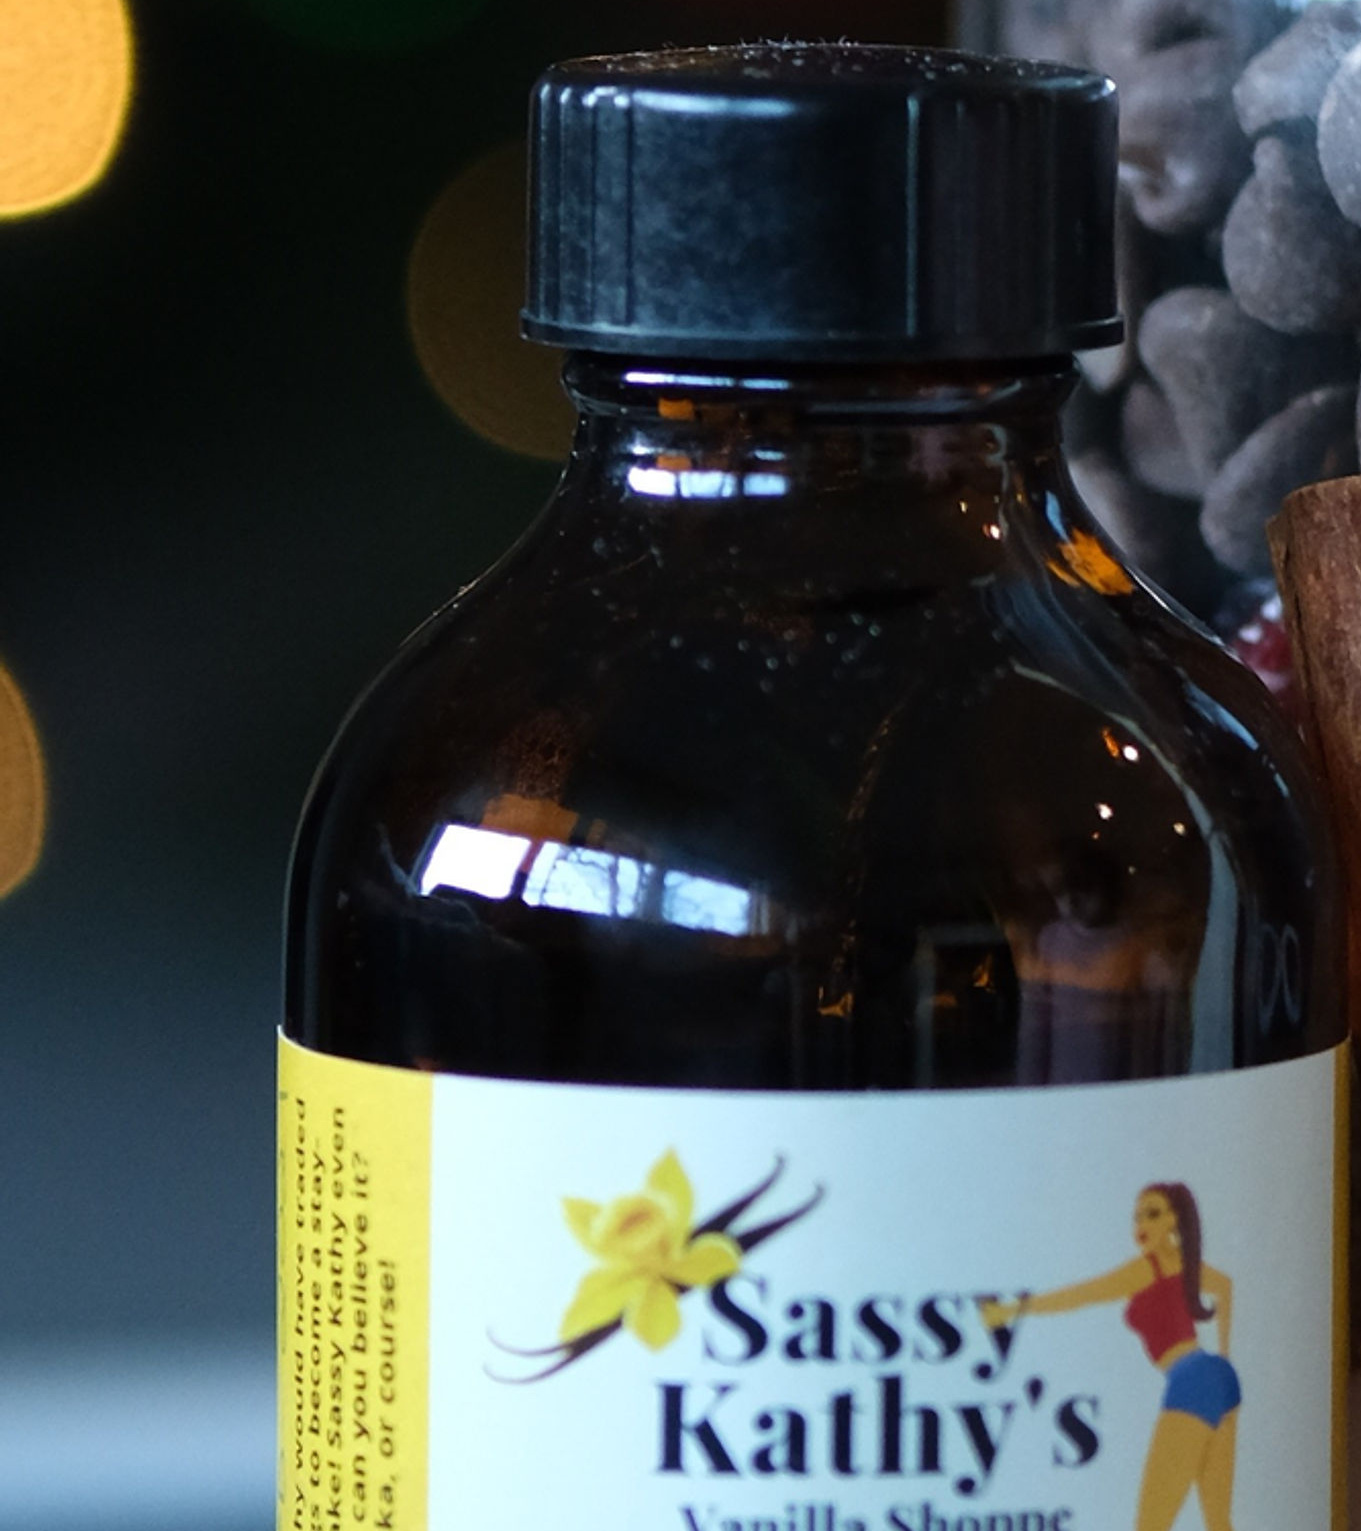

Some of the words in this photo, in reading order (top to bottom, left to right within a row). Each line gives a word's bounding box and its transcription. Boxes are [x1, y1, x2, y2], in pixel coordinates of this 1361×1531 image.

[295, 1096, 306, 1228] traded
[310, 1137, 325, 1233] stay-
[331, 1107, 344, 1200] even
[351, 1153, 369, 1199] it?
[294, 1243, 305, 1336] have
[311, 1248, 322, 1268] a
[328, 1211, 347, 1327] Kathy
[350, 1214, 369, 1353] believe
[308, 1281, 322, 1436] become
[378, 1260, 396, 1403] course!
[703, 1274, 1032, 1381] Sassy
[293, 1350, 304, 1471] would
[326, 1340, 346, 1449] Sassy
[352, 1369, 370, 1438] you
[378, 1417, 394, 1458] or
[655, 1374, 1102, 1498] Kathy's
[309, 1451, 321, 1487] to
[352, 1455, 367, 1522] can
